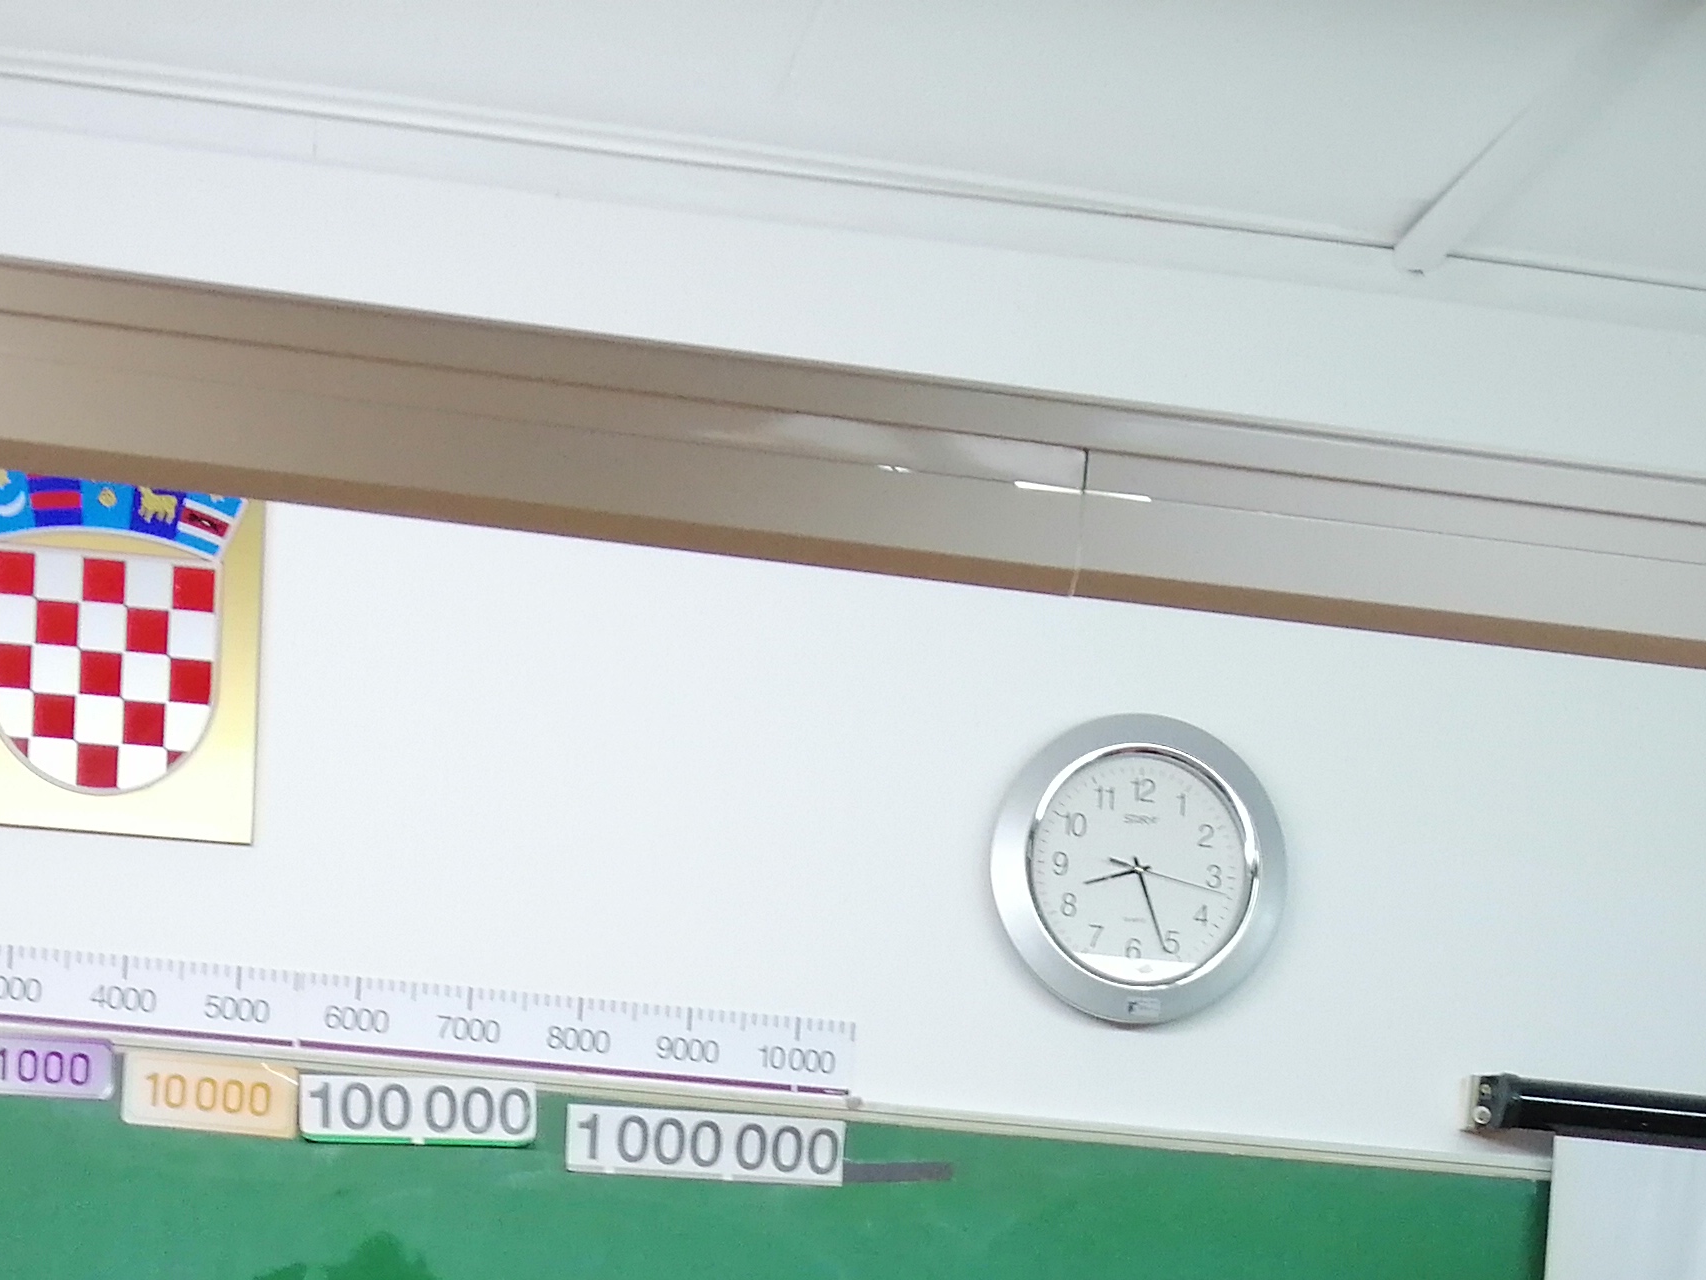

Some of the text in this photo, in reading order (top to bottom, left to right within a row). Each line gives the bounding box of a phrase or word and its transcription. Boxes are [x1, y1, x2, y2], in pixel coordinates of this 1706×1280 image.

[1094, 785, 1117, 811] 11
[1130, 777, 1157, 804] 12
[1175, 792, 1187, 817] 1
[1058, 812, 1088, 838] 10
[1196, 823, 1216, 849] 2
[1051, 851, 1070, 876] 9
[1205, 863, 1223, 889] 3
[1060, 892, 1078, 917] 8
[1193, 904, 1209, 927] 4
[1088, 923, 1105, 949] 7
[1125, 938, 1142, 959] 6
[1164, 929, 1181, 955] 5
[91, 985, 157, 1014] 4000
[205, 995, 269, 1025] 5000
[323, 1005, 390, 1034] 6000
[438, 1015, 501, 1045] 7000
[546, 1026, 611, 1055] 8000
[655, 1037, 720, 1065] 9000
